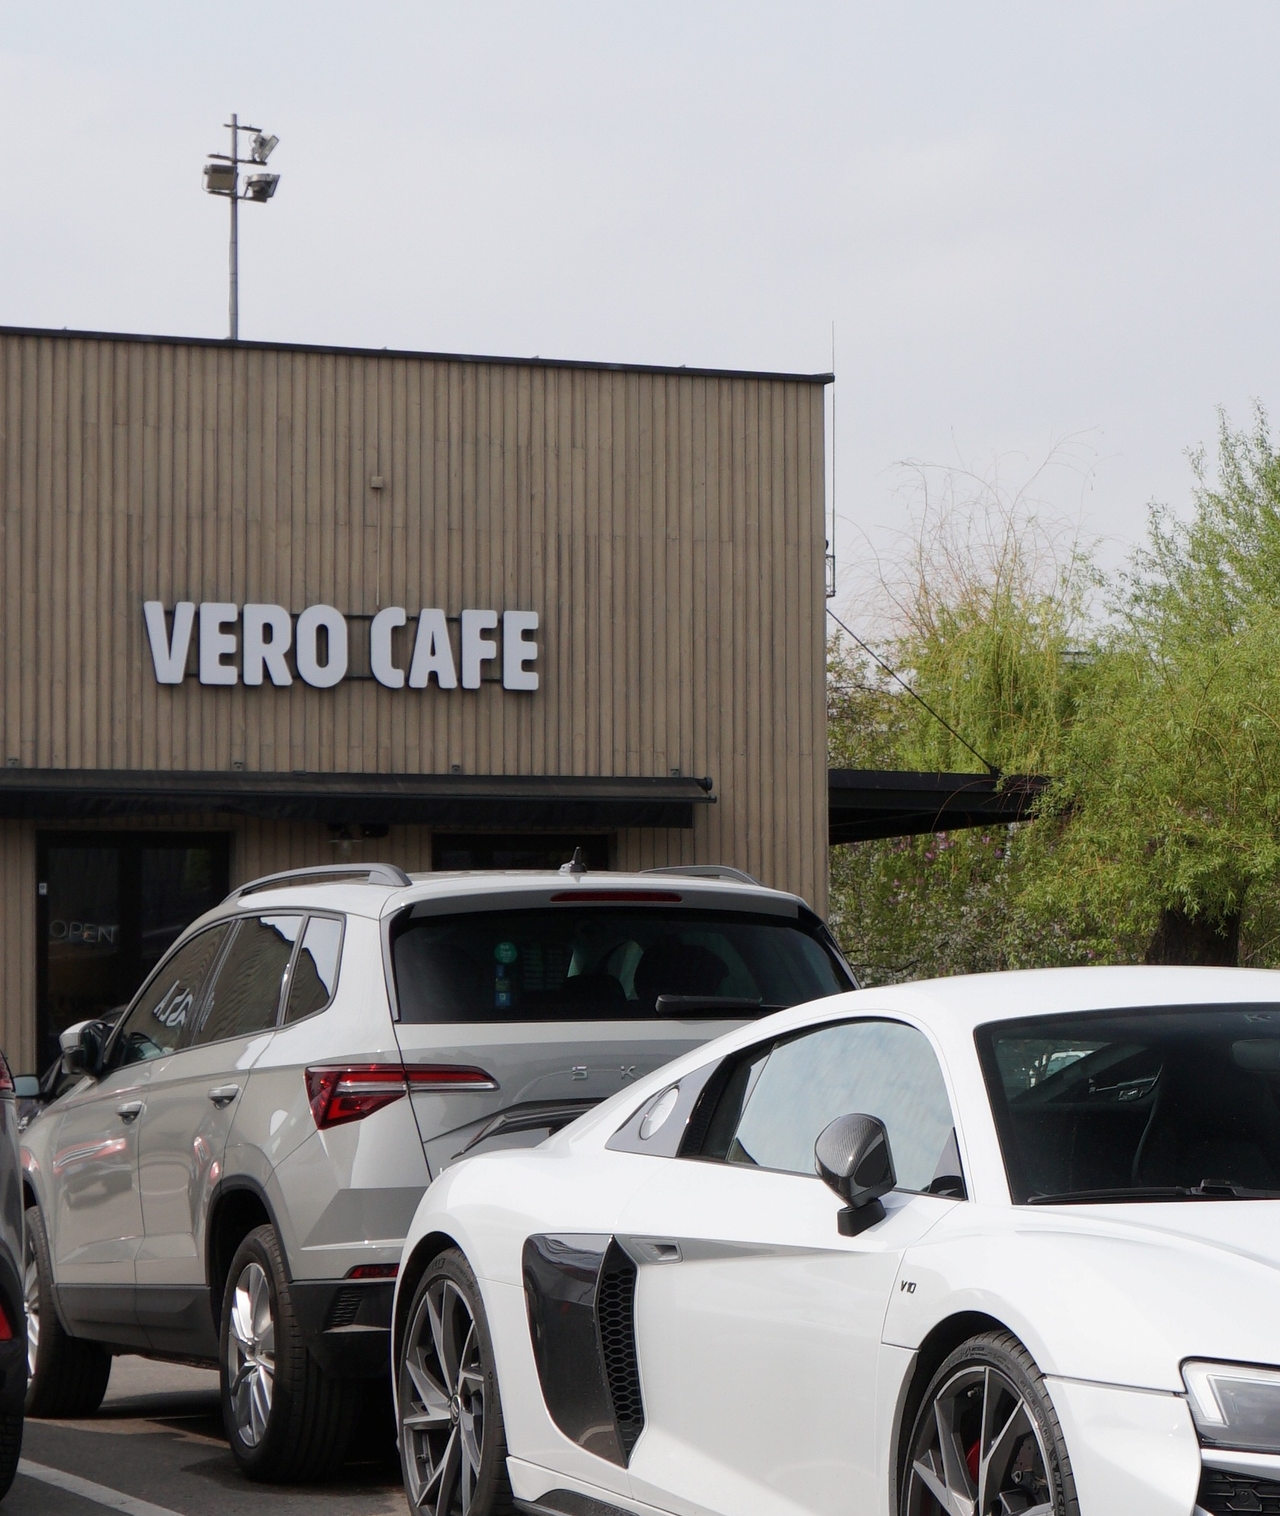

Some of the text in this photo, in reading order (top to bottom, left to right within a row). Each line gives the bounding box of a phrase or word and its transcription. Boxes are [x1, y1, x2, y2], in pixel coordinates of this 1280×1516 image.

[143, 600, 539, 691] VERO CAFE
[49, 920, 115, 944] OPEN
[901, 1280, 917, 1294] V10
